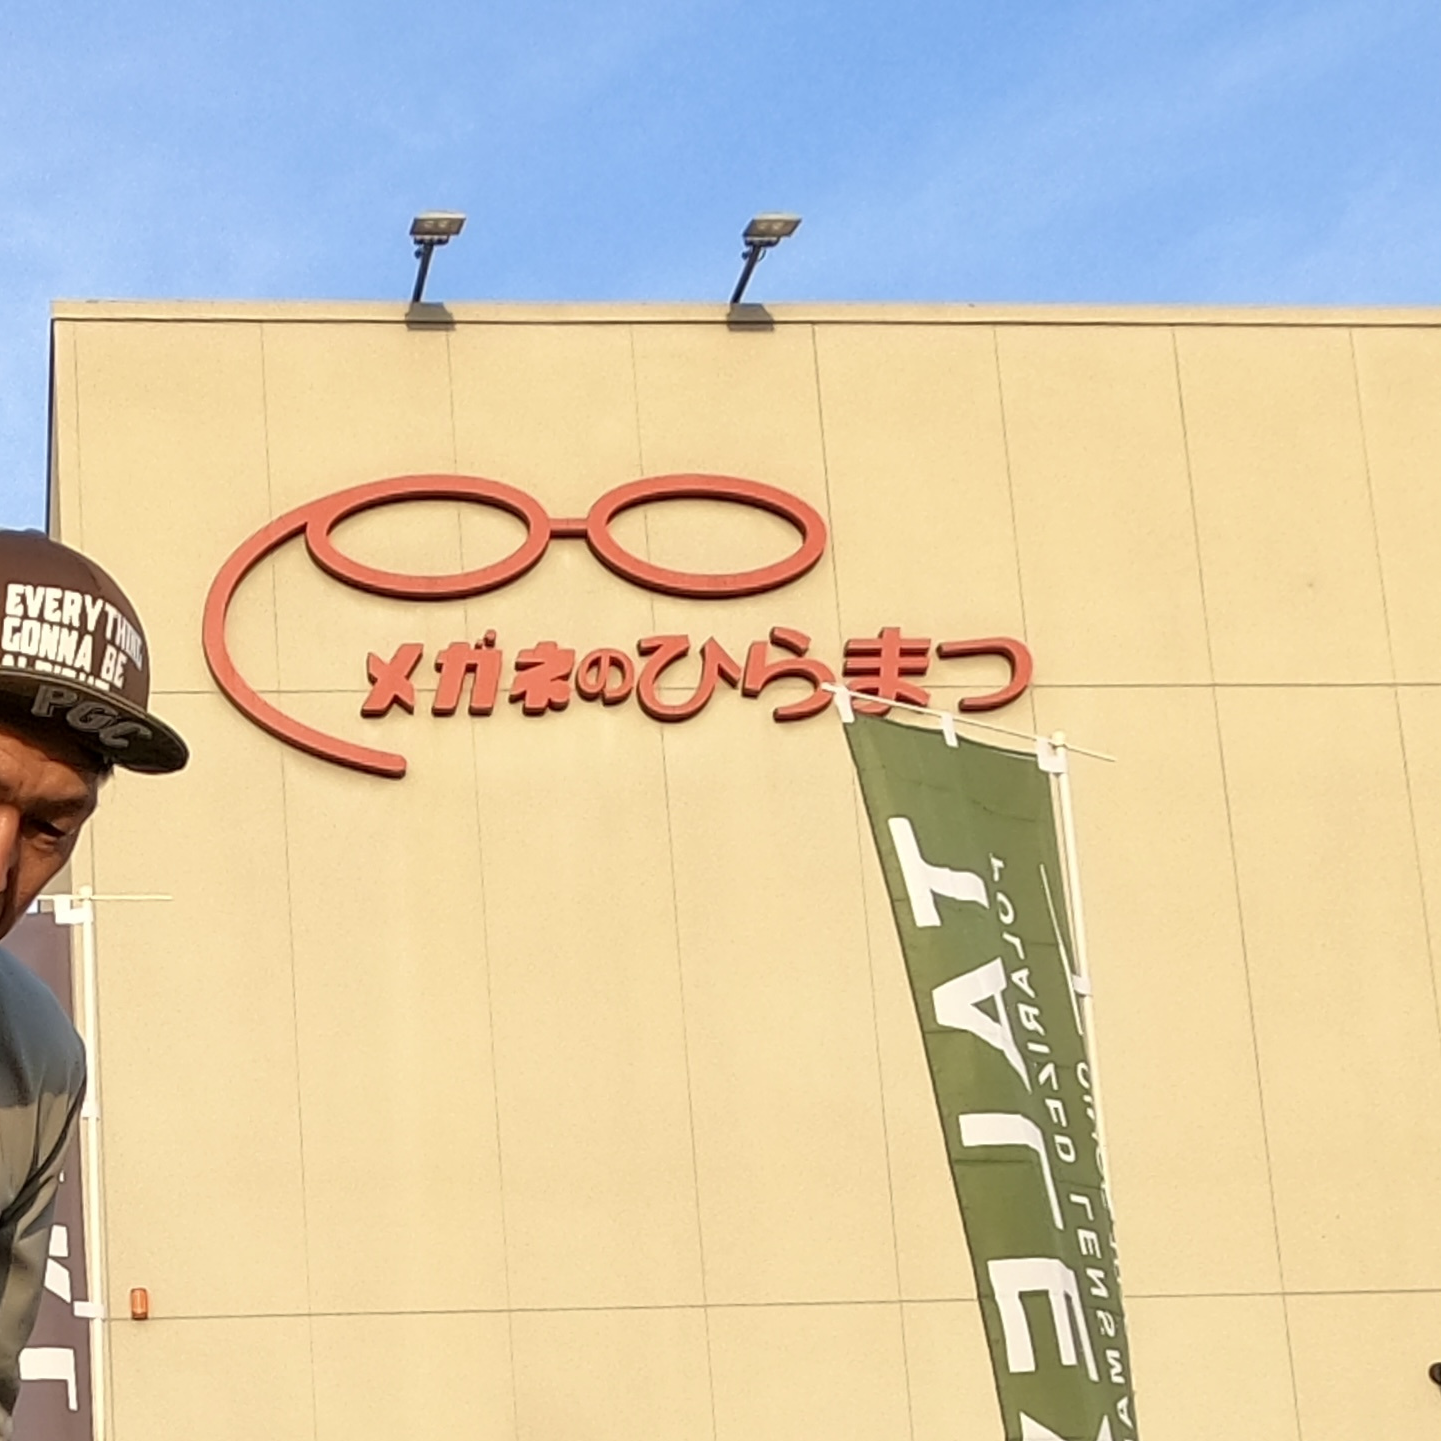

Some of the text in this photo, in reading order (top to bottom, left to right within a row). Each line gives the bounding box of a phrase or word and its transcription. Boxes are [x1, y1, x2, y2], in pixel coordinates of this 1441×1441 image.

[1, 615, 93, 674] GONNA
[100, 643, 128, 690] BE
[361, 626, 1034, 722] メガネのひらまつ
[30, 684, 153, 749] PGC
